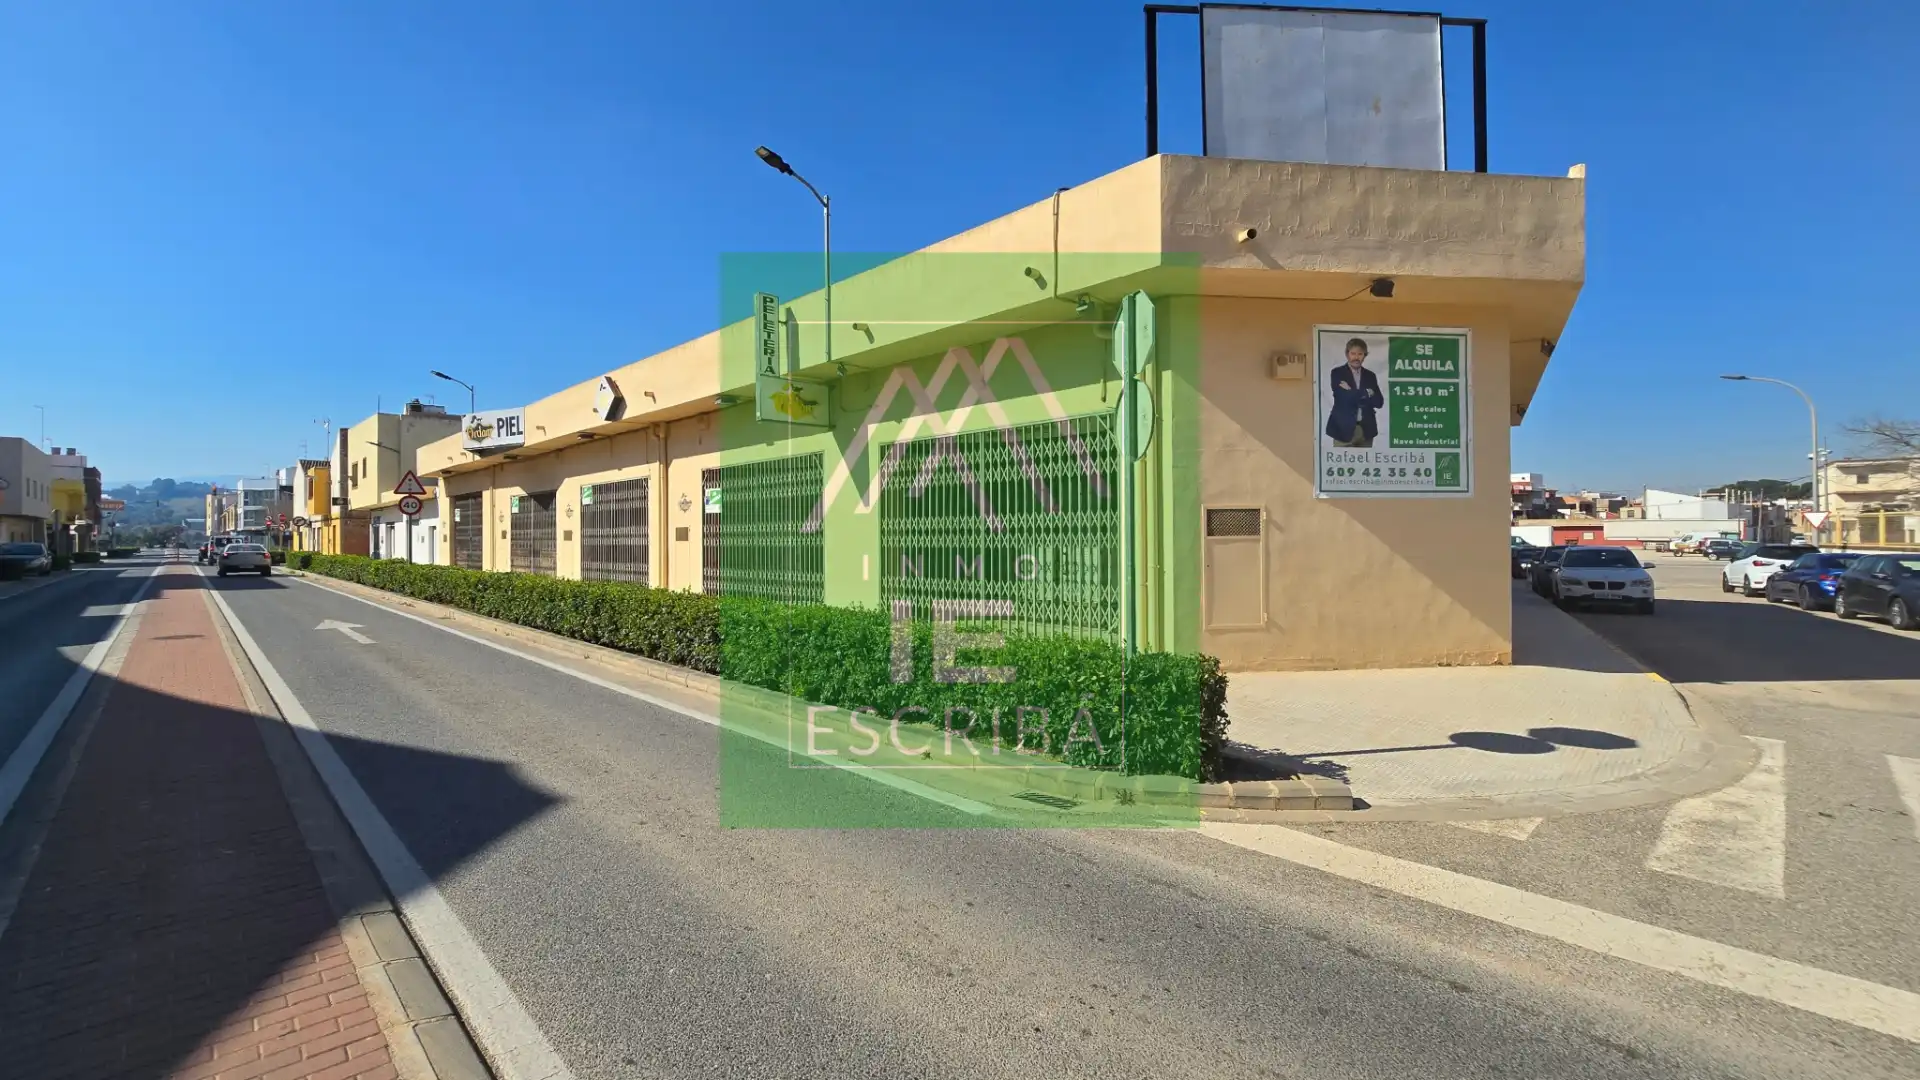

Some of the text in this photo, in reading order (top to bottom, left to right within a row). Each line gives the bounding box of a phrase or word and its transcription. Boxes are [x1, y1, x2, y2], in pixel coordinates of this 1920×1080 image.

[762, 295, 776, 375] PELETERIA
[1415, 344, 1434, 355] SE
[1395, 359, 1454, 371] ALQUILA
[1394, 386, 1432, 396] 1.310
[1414, 405, 1447, 413] Locales
[497, 415, 523, 438] PIEL
[1326, 451, 1425, 463] Rafael Escribá
[1326, 467, 1432, 477] 609 42 35 40
